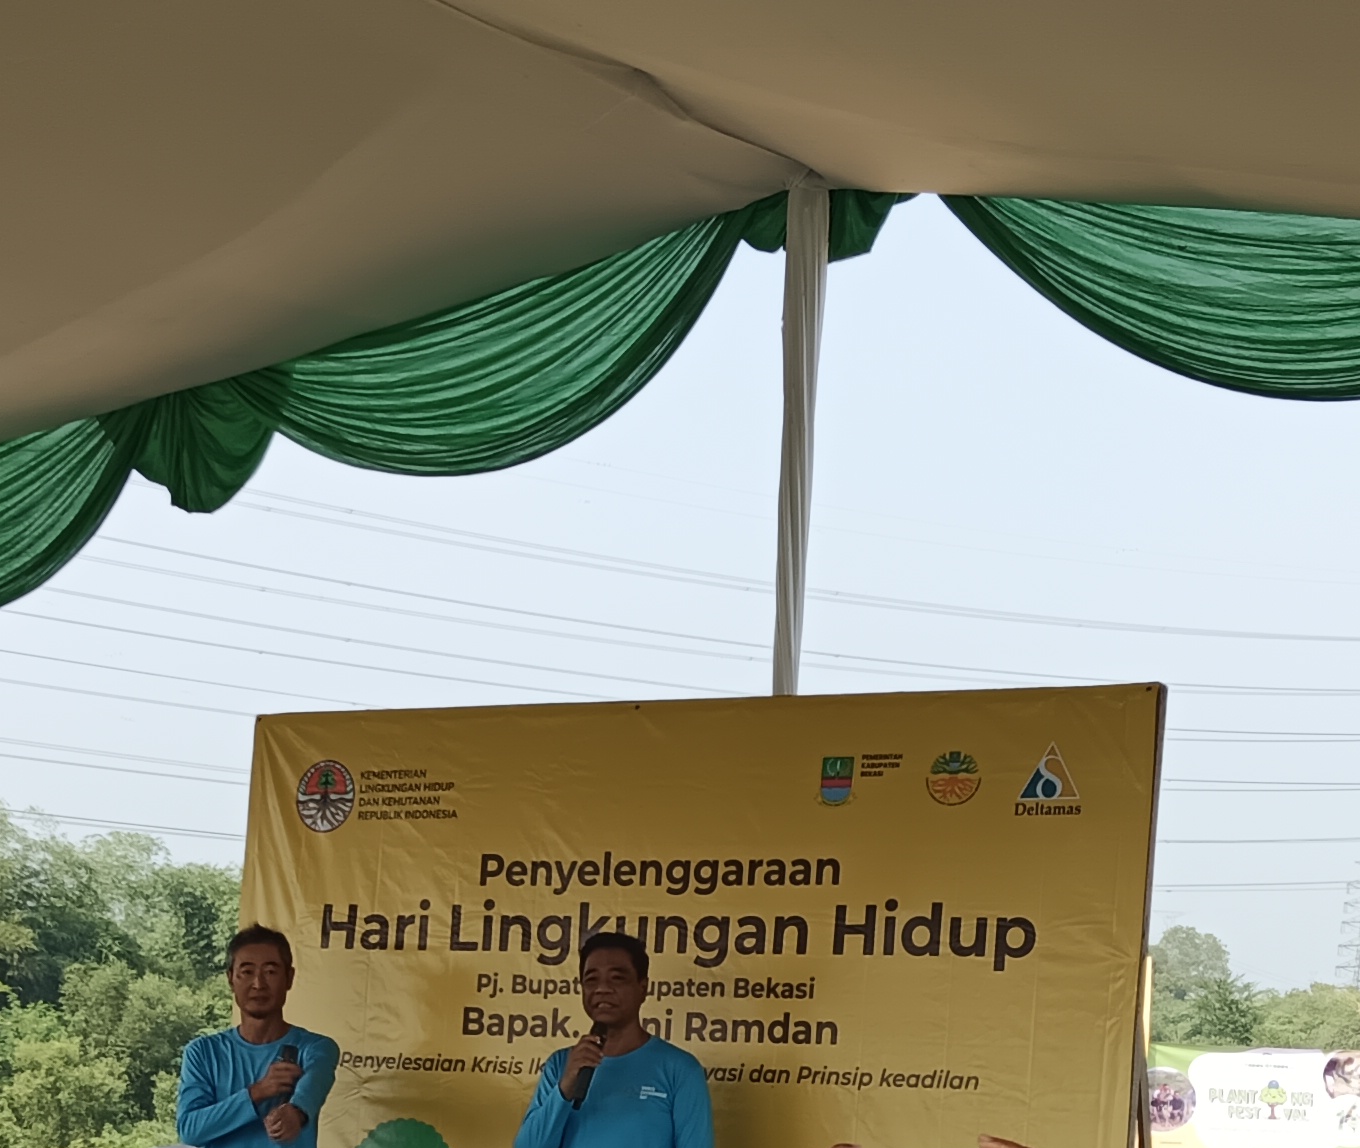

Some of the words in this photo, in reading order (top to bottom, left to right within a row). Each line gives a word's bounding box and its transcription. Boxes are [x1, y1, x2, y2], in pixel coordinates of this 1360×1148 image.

[360, 769, 427, 780] KEMENTERIAN
[359, 783, 422, 794] LINGKUNGAN
[423, 782, 455, 792] HIDUP
[358, 797, 380, 807] DAN
[381, 796, 440, 806] KEHUTANAN
[1014, 802, 1082, 816] Deltamas
[358, 810, 403, 820] REPUBLIK
[405, 809, 458, 820] INDONESIA
[479, 852, 840, 896] Penyelenggaraan
[320, 899, 430, 950] Hari
[832, 899, 1037, 971] Hidup
[477, 973, 504, 998] Pj.
[512, 974, 582, 999] Bupat
[733, 977, 815, 999] Bekasi
[462, 1007, 580, 1043] Bapak.
[642, 1008, 673, 1041] ni
[685, 1011, 838, 1045] Ramdan
[340, 1051, 465, 1073] Penyelesaian
[471, 1055, 523, 1075] Krisis
[703, 1063, 745, 1082] vasi
[749, 1064, 790, 1084] dan
[796, 1065, 873, 1091] Prinsip
[879, 1068, 980, 1091] keadilan
